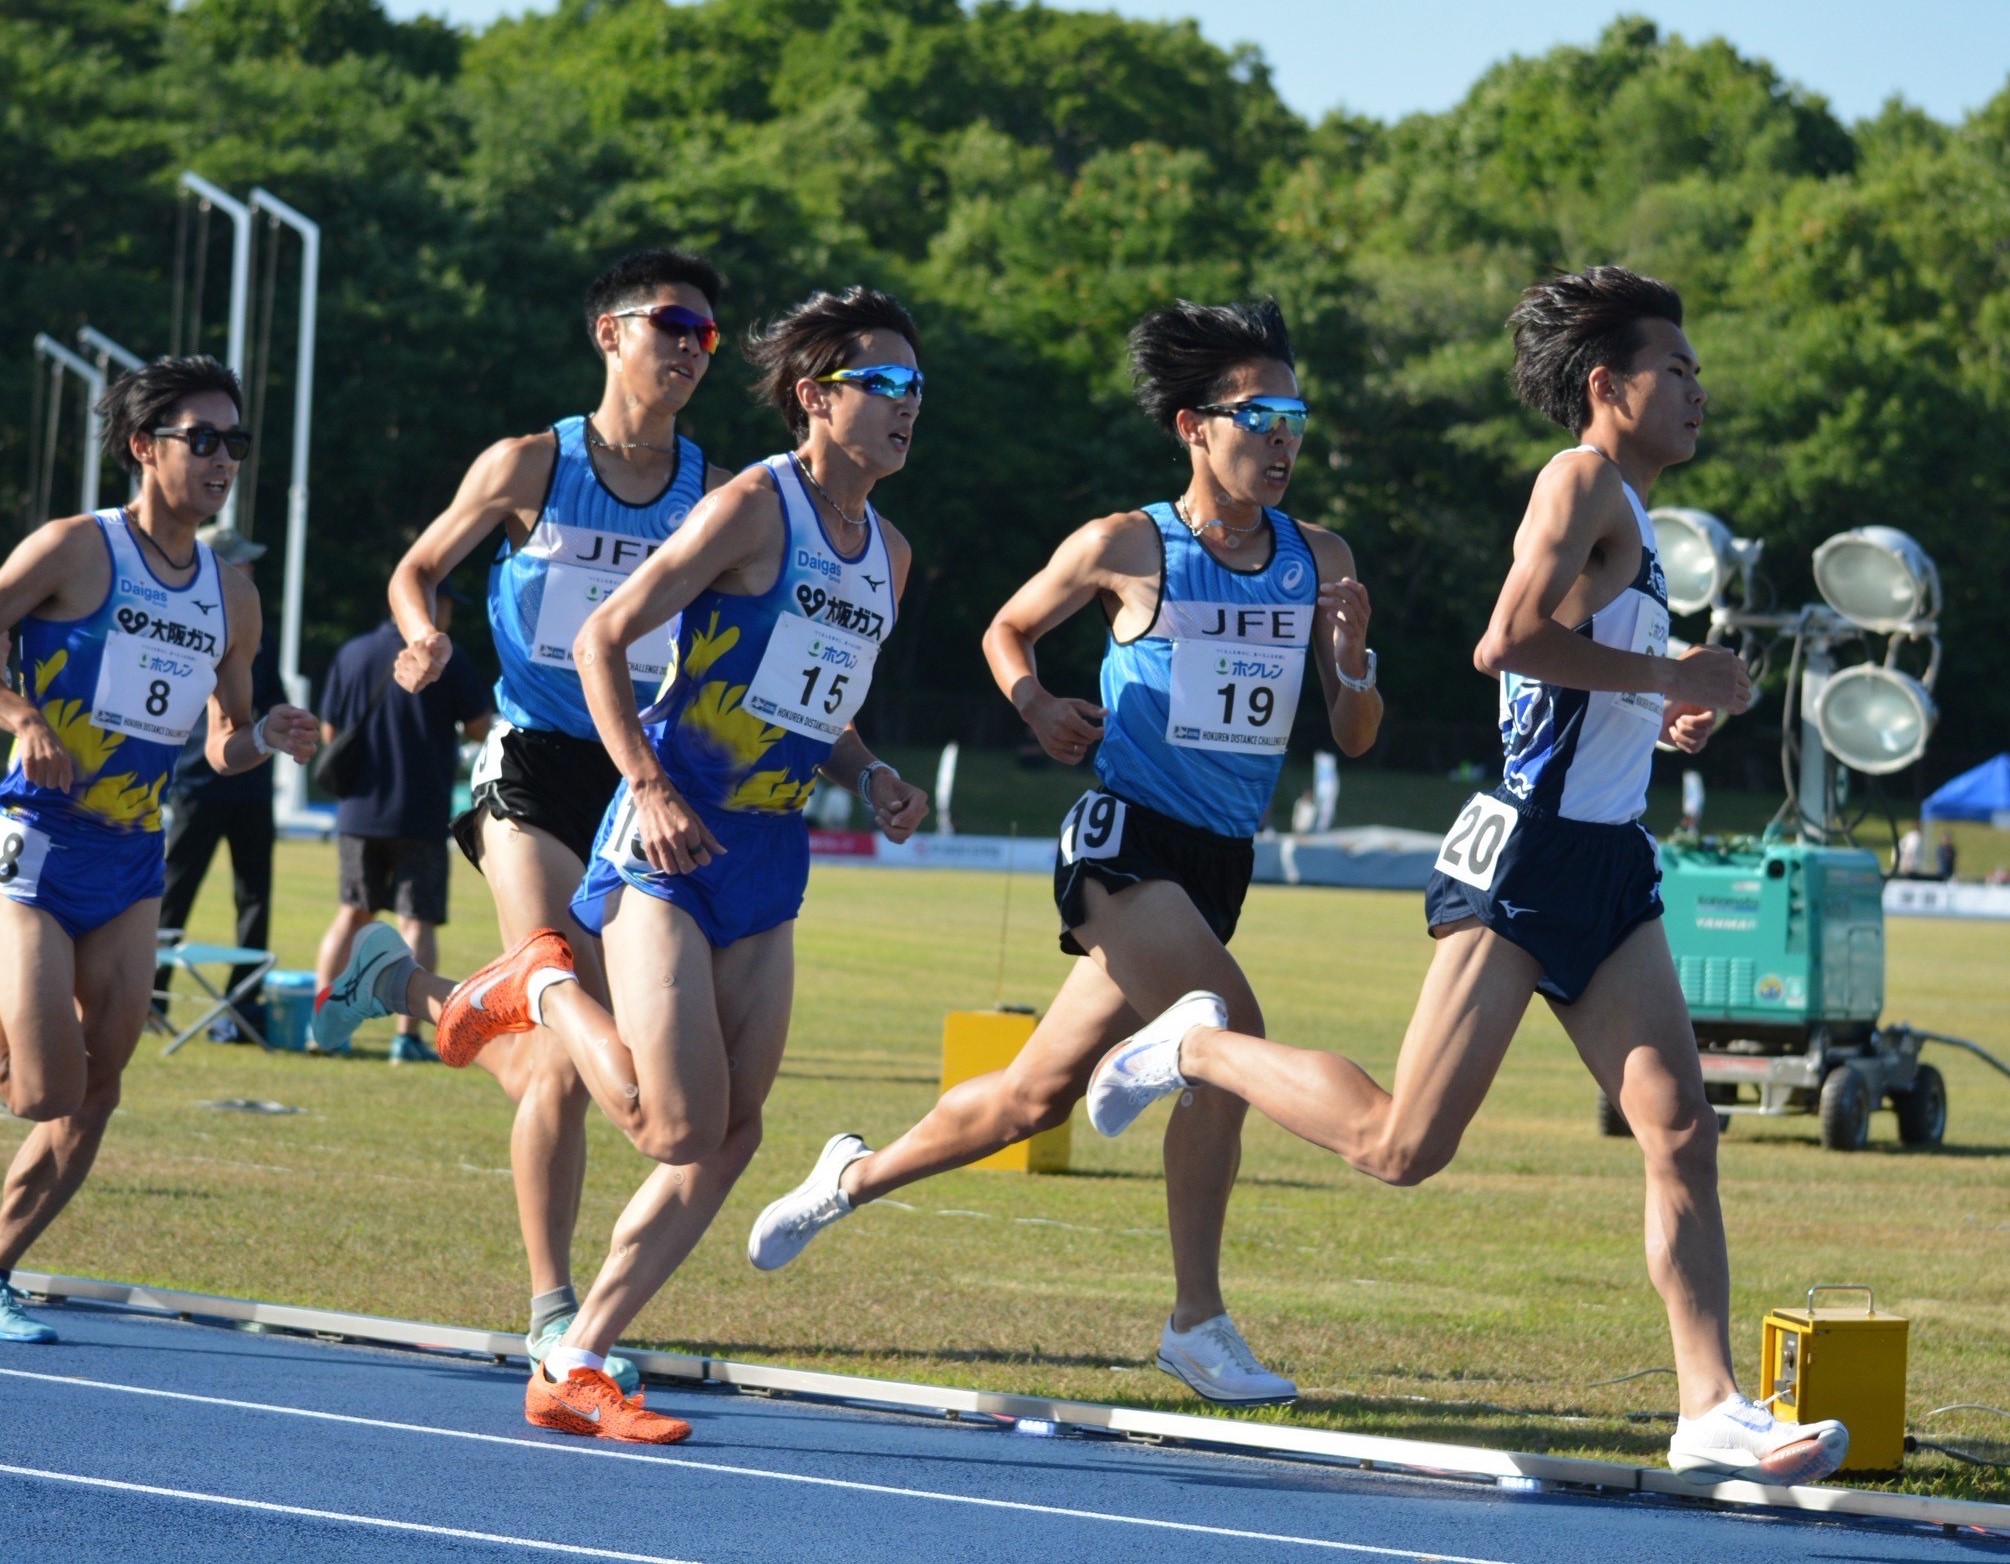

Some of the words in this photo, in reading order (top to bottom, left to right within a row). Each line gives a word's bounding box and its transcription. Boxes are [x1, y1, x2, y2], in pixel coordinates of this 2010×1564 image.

[797, 550, 842, 577] Daigas
[120, 578, 168, 601] Daigas
[824, 596, 885, 641] 大阪ガス
[1201, 609, 1296, 639] JFE
[150, 618, 218, 658] 大阪ガス
[150, 657, 193, 678] ホクレン
[821, 646, 858, 670] ホクレン
[1232, 660, 1284, 680] ホクレン
[145, 679, 171, 717] 8
[800, 665, 850, 715] 15
[1217, 682, 1275, 727] 19
[1202, 730, 1230, 742] HOKUREN
[1230, 733, 1258, 745] DISTANCE
[1071, 796, 1117, 852] 19
[1443, 804, 1506, 876] 20
[0, 832, 24, 884] 8
